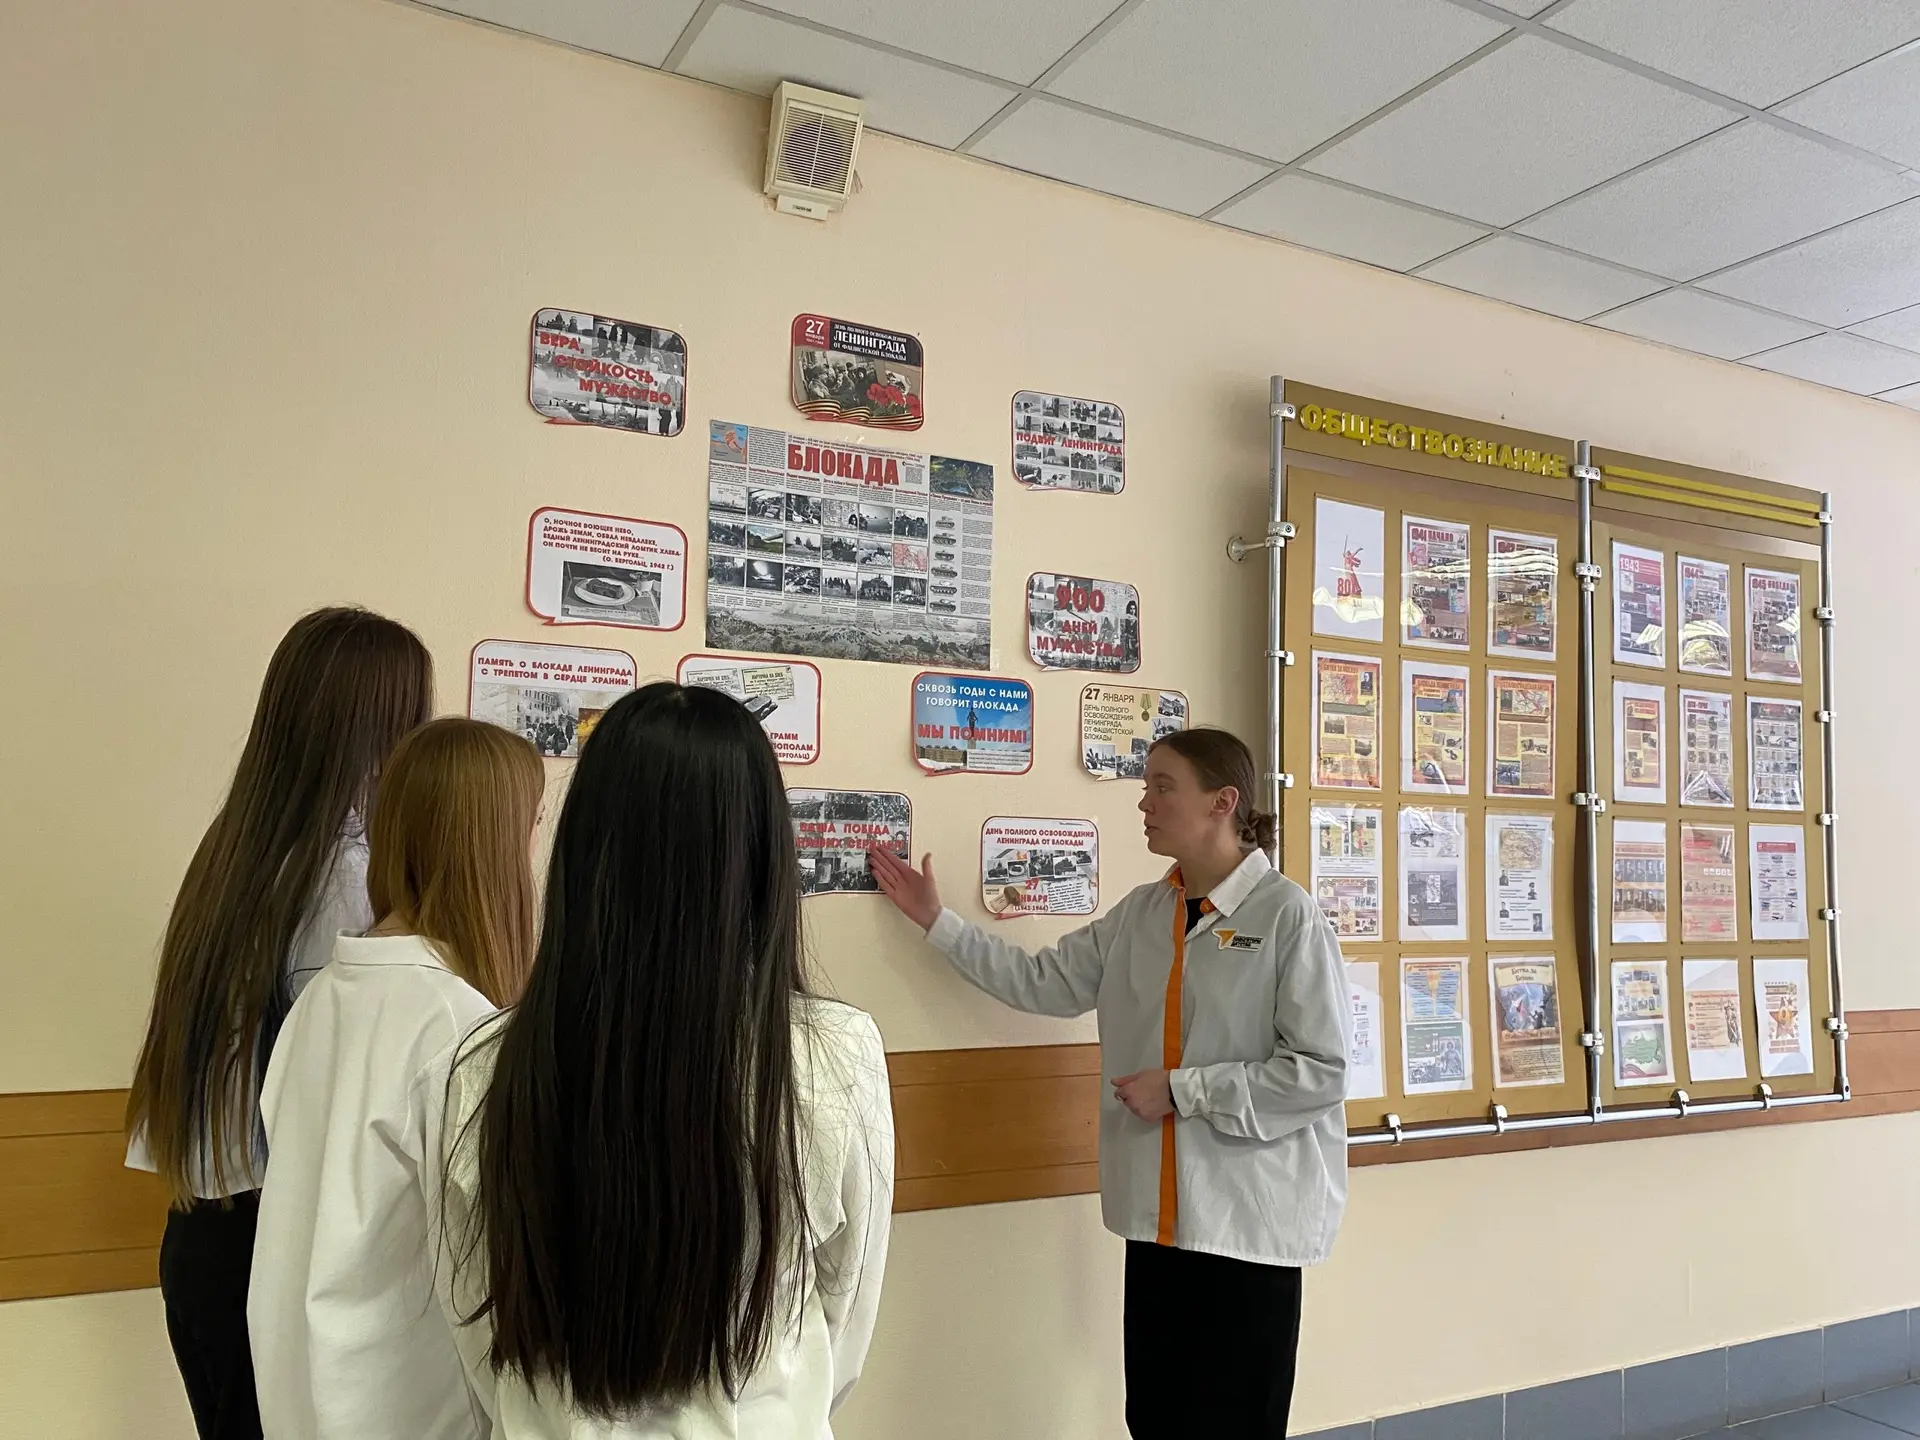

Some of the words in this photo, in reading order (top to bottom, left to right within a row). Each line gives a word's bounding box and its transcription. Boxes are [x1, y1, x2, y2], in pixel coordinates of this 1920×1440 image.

[806, 319, 824, 334] 27
[539, 331, 584, 354] ВЕРА,
[833, 330, 906, 354] ЛЕНИНГРАДА
[841, 344, 880, 356] ФАШИСТСКОЙ
[880, 352, 907, 361] БЛОКАДЫ
[553, 354, 658, 386] СТОЙКОСТЬ,
[1016, 432, 1056, 446] ПОДВИГ
[1061, 437, 1122, 455] ЛЕНИНГРАДА
[1300, 403, 1568, 479] ОБЩЕСТВОЗНАНИЕ
[787, 443, 900, 486] БЛОКАДА
[544, 517, 552, 525] О,
[554, 518, 582, 528] НОЧНОЕ
[583, 522, 613, 532] ВОЮЩЕЕ
[615, 526, 634, 536] НЕБО,
[543, 525, 567, 534] ДРОЖЬ
[570, 528, 595, 538] ЗЕМЛИ,
[596, 532, 619, 541] ОБВАЛ
[620, 535, 658, 547] НЕВДАЛЕКЕ,
[543, 533, 570, 542] БЕДНЫЙ
[572, 537, 629, 550] ЛЕНИНГРАДСКИЙ
[631, 544, 658, 553] ЛОМТИК
[1428, 529, 1453, 543] НАЧАЛО
[543, 540, 554, 548] ОН
[555, 542, 578, 551] ПОЧТИ
[589, 546, 611, 555] ВЕСИТ
[612, 549, 622, 557] НА
[649, 561, 665, 569] 1942
[1620, 556, 1640, 573] 1943
[1337, 577, 1350, 597] 80
[1056, 583, 1105, 613] 900
[1062, 619, 1097, 635] ДНЕЙ
[1036, 635, 1125, 657] МУЖЕСТВА
[478, 657, 514, 667] ПАМЯТЬ
[519, 660, 526, 668] О
[532, 661, 573, 672] БЛОКАДЕ
[577, 664, 633, 677] ЛЕНИНГРАДА
[481, 668, 488, 676] С
[493, 669, 538, 680] ТРЕПЕТОМ
[543, 672, 549, 680] В
[553, 674, 587, 684] СЕРДЦЕ
[591, 676, 632, 686] ХРАНИМ.
[916, 683, 957, 694] СКВОЗЬ
[959, 686, 986, 697] ГОДЫ
[989, 689, 997, 697] С
[999, 689, 1028, 699] НАМИ
[1085, 688, 1100, 700] 27
[1103, 692, 1134, 703] ЯНВАРЯ
[926, 697, 970, 708] ГОВОРИТ
[972, 700, 1021, 712] БЛОКАДА.
[1101, 705, 1129, 713] ПОЛНОГО
[1084, 711, 1134, 721] ОСВОБОЖДЕНИЯ
[1084, 719, 1122, 727] ЛЕНИНГРАДА
[770, 732, 798, 740] ГРАММ
[917, 723, 944, 739] МЫ
[950, 725, 1027, 743] ПОМНИМ!
[1084, 733, 1112, 741] БЛОКАДЫ
[1093, 727, 1134, 735] ФАШИСТСКОЙ
[844, 823, 890, 835] ПОБЕДА
[985, 828, 1003, 836] ДЕНЬ
[1004, 828, 1037, 836] ПОЛНОГО
[1038, 829, 1094, 838] ОСВОБОЖДЕНИЯ
[996, 837, 1040, 845] ЛЕНИНГРАДА
[1051, 838, 1084, 847] БЛОКАДЫ
[1025, 877, 1040, 890] 27
[1015, 894, 1048, 903] ЯНВАРЯ
